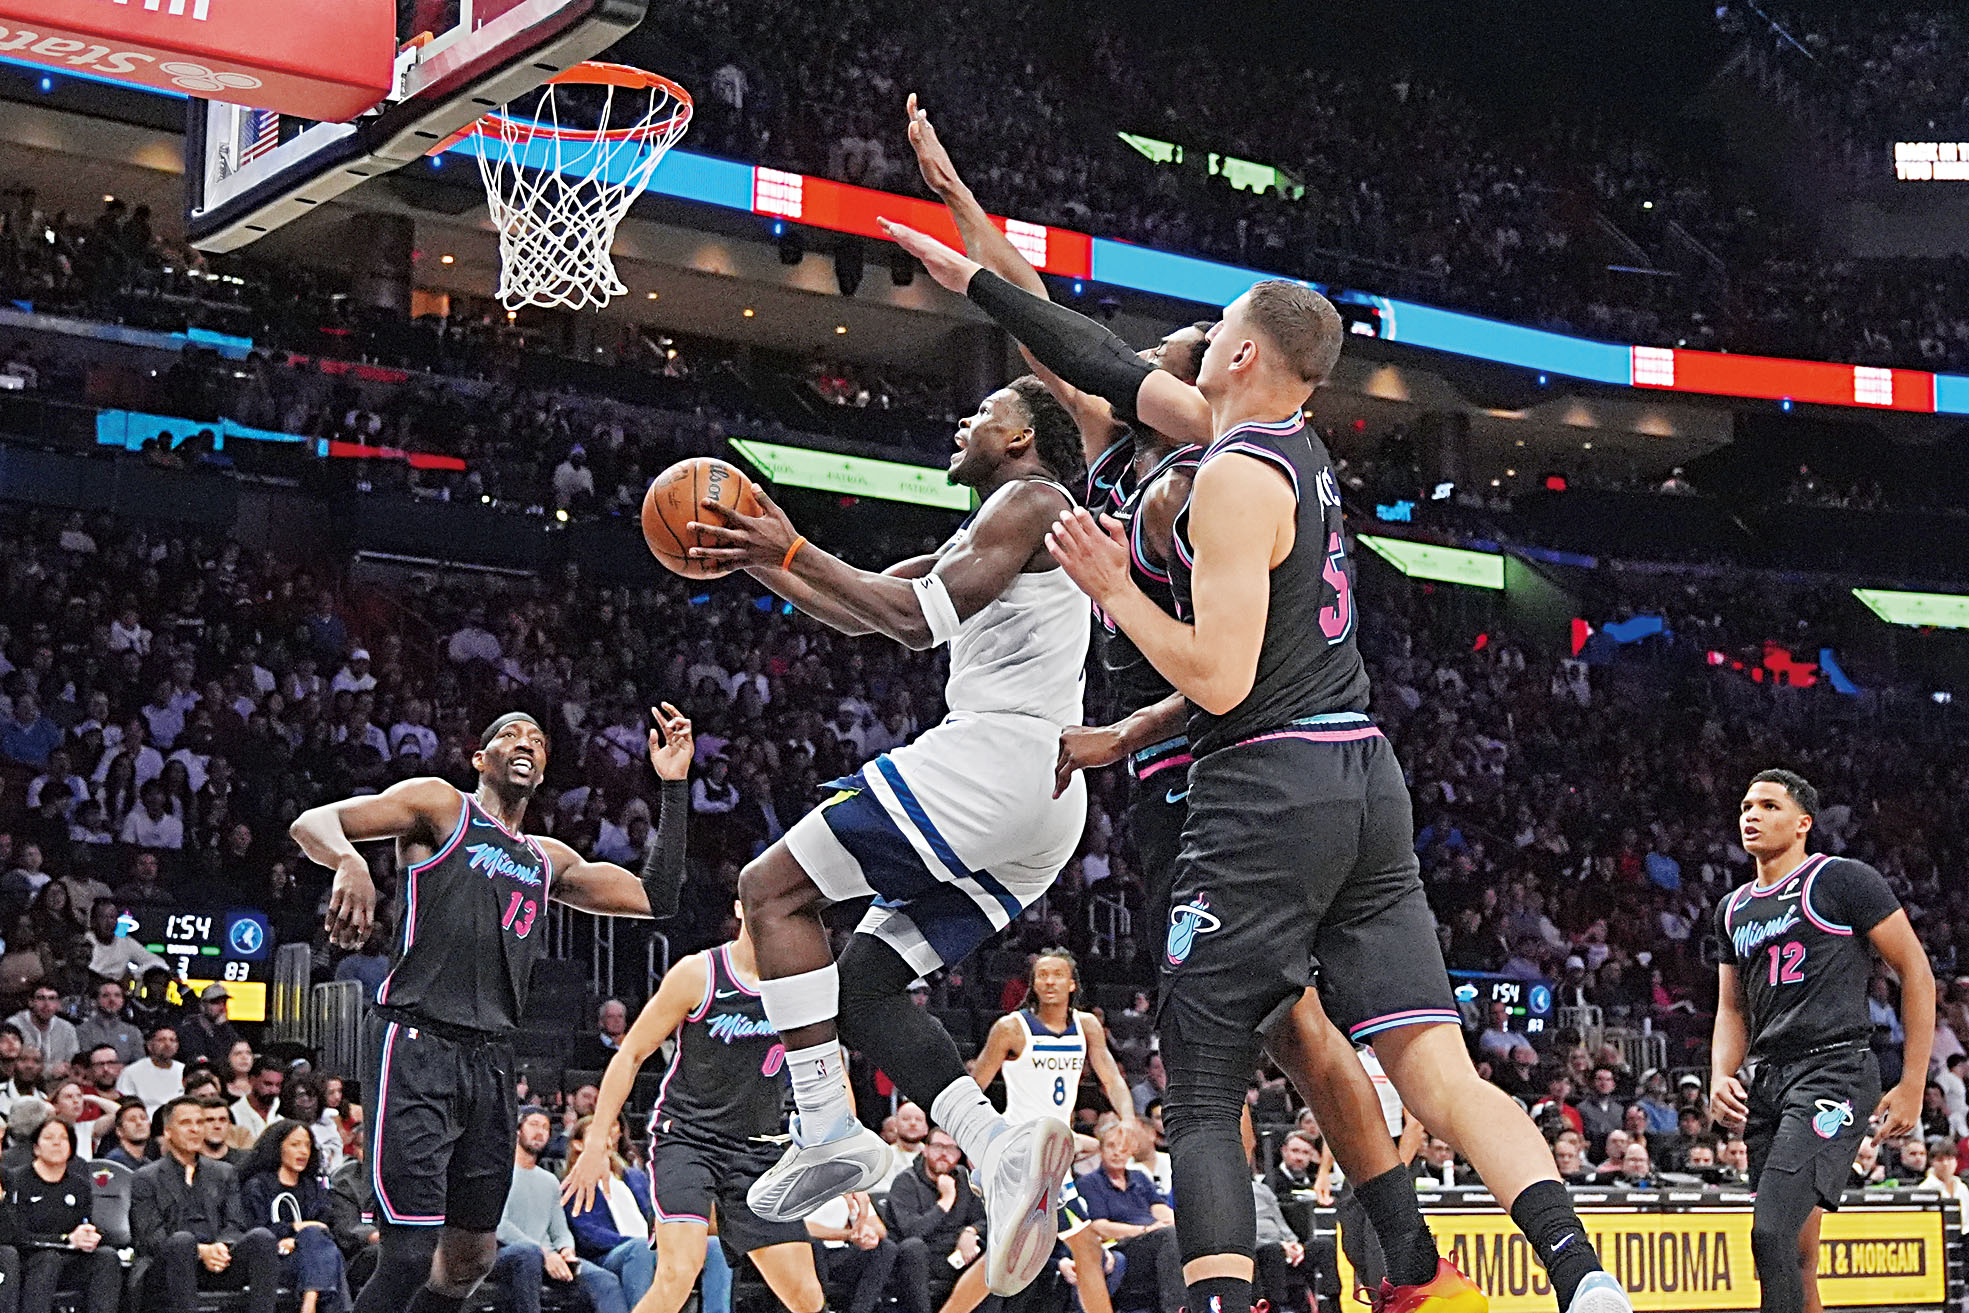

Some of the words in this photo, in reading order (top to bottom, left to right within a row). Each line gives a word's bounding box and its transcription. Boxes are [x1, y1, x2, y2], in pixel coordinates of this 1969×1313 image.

[0, 26, 156, 73] Stat
[465, 843, 541, 887] Miami
[166, 915, 212, 940] 1:54
[502, 891, 538, 939] 13
[1732, 904, 1800, 957] Miami
[224, 961, 250, 982] 83
[1768, 941, 1806, 986] 12
[761, 1043, 786, 1077] 0
[1032, 1057, 1084, 1071] WOLVES
[1053, 1076, 1065, 1106] 8
[1615, 1232, 1732, 1293] IDIOMA
[1836, 1243, 1849, 1275] &
[1851, 1241, 1920, 1275] MORGAN
